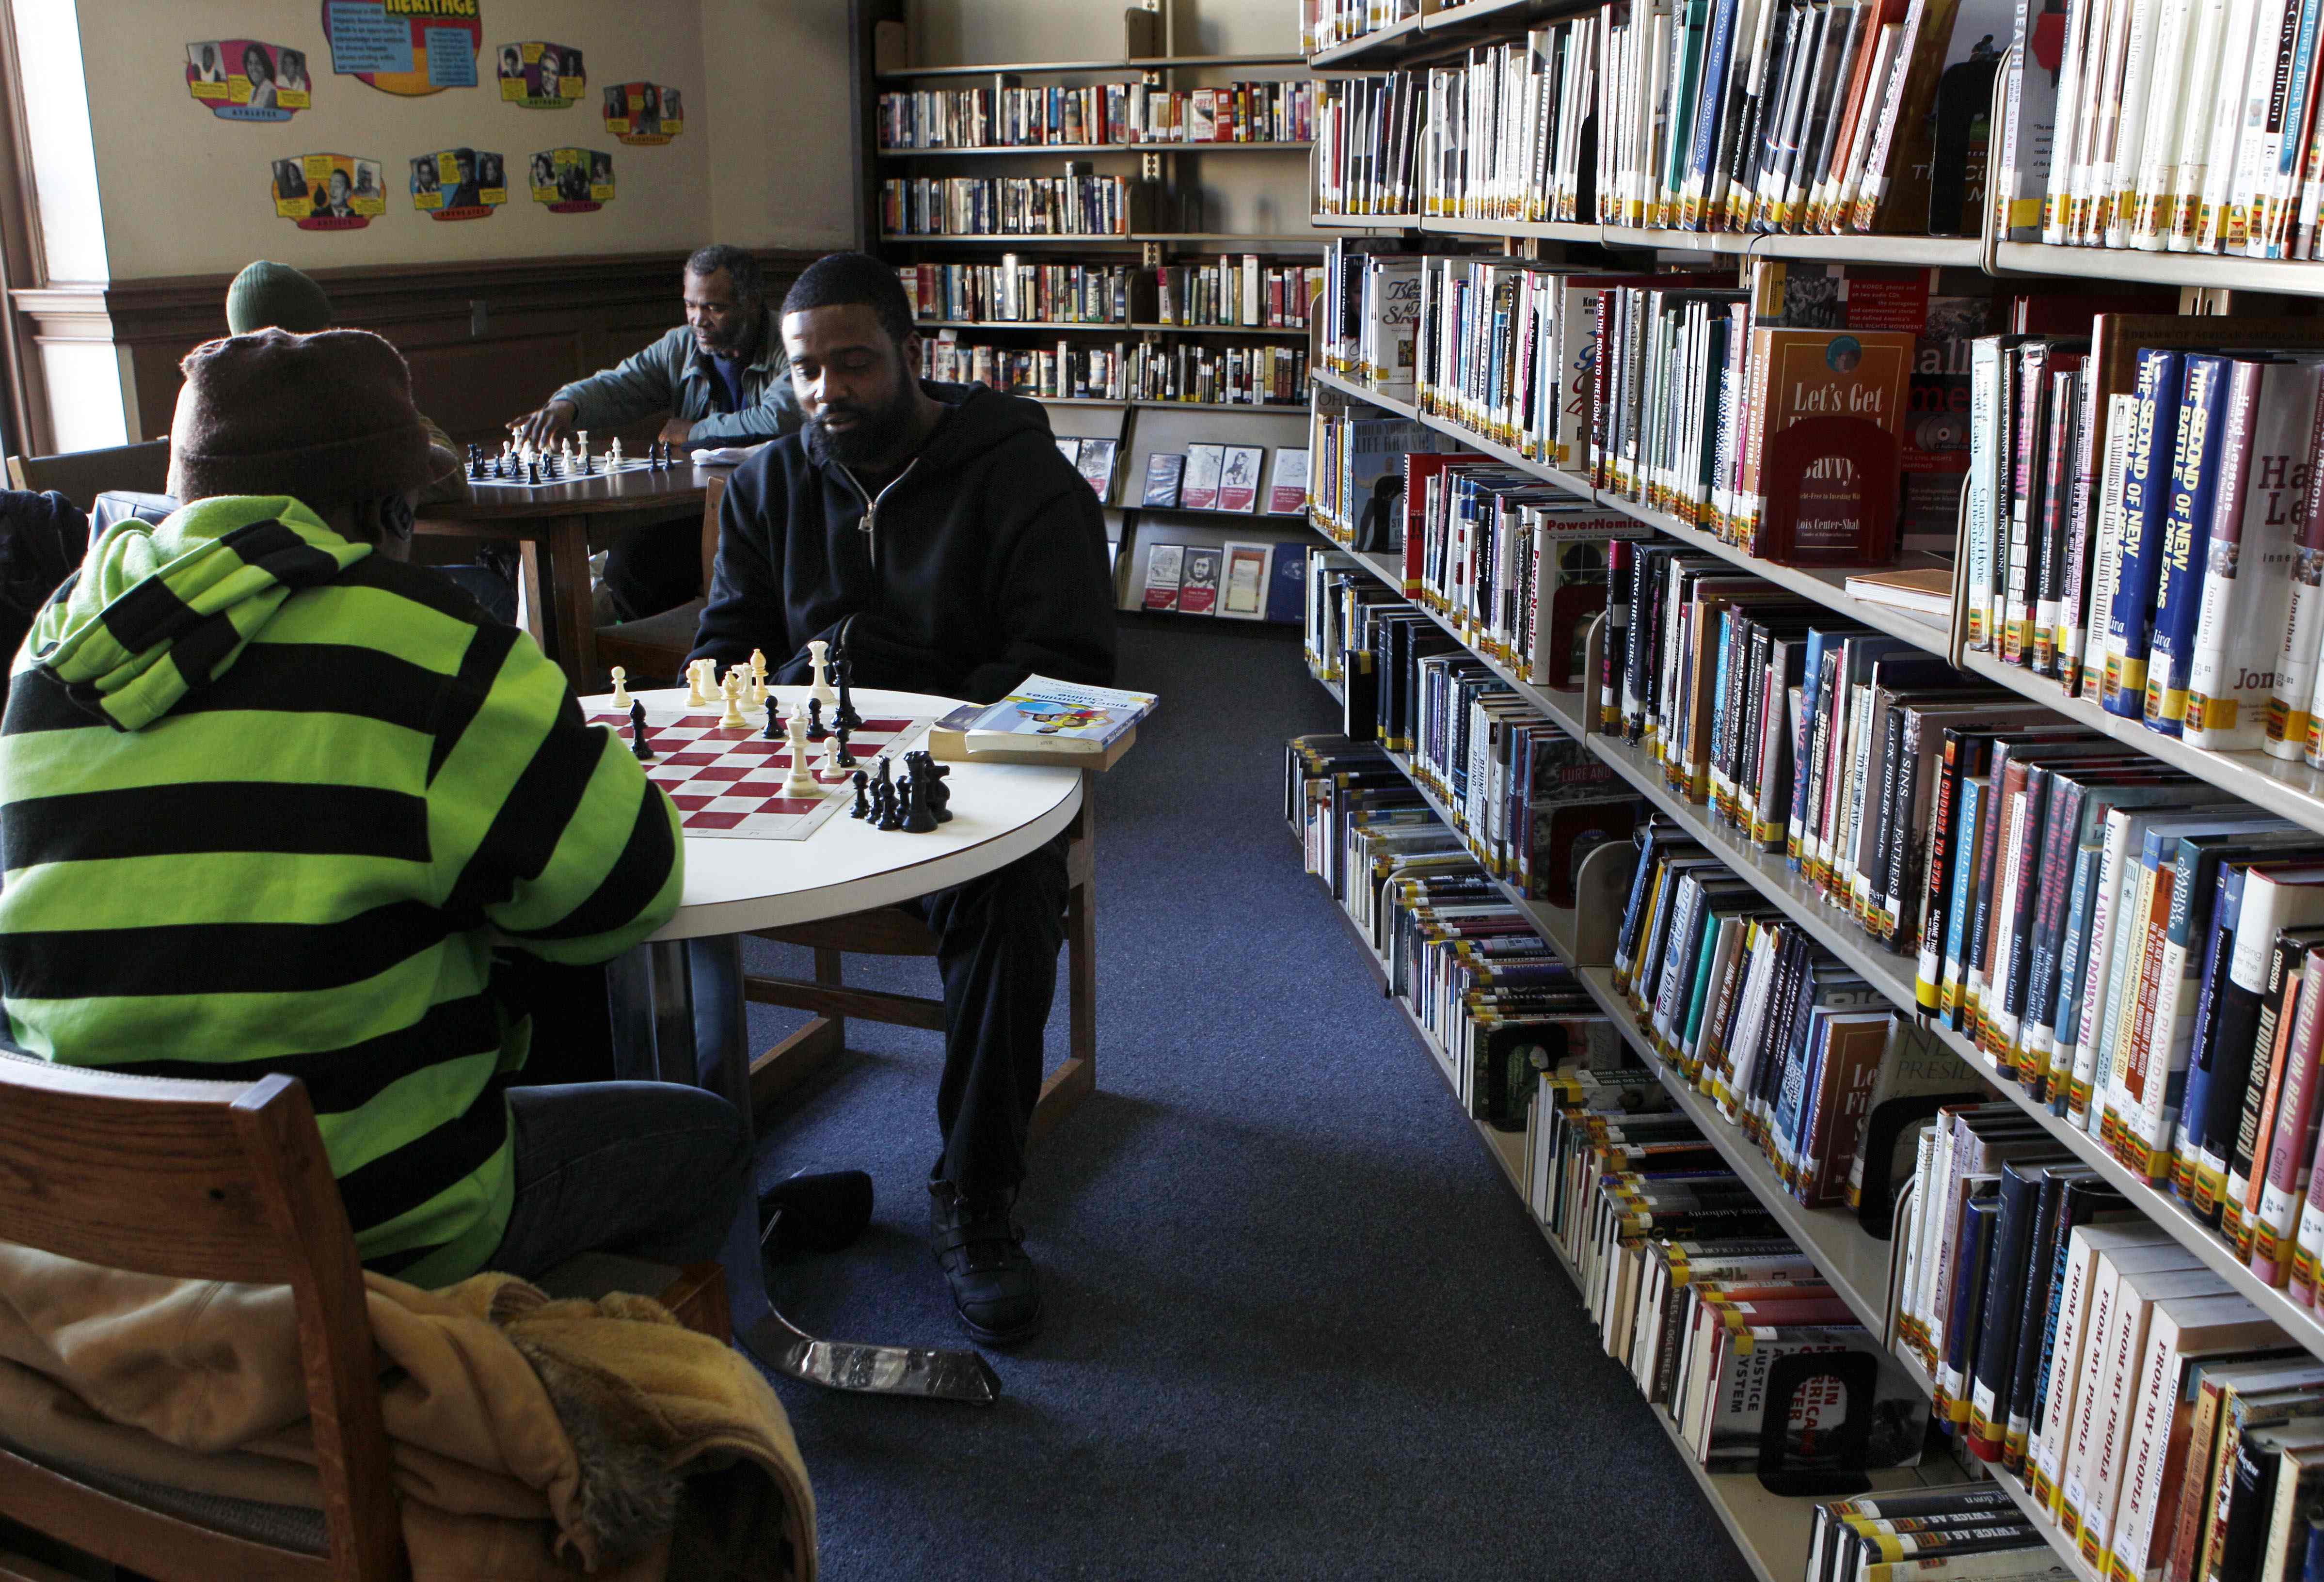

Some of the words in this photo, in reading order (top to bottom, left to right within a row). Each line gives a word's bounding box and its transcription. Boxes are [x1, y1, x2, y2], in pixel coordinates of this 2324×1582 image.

[2011, 4, 2027, 66] DEATH
[2006, 111, 2015, 148] SUSAN
[1598, 302, 1605, 315] ON
[1595, 363, 1602, 375] TO
[1752, 354, 1761, 408] FREEDOM'S
[2138, 362, 2153, 395] THE
[2189, 368, 2208, 401] THE
[1592, 377, 1601, 422] FREEDOM
[1794, 382, 1842, 411] Let's
[1849, 382, 1884, 412] Get
[2126, 398, 2141, 471] BATTLE
[2233, 395, 2250, 438] Hard
[1746, 410, 1758, 466] DAUGHTERS
[2133, 398, 2156, 480] SECOND
[2172, 405, 2190, 481] BATTLE
[2182, 408, 2208, 491] SECOND
[2127, 483, 2143, 507] OF
[2224, 443, 2243, 512] Lessons
[2309, 449, 2324, 520] Lessons
[1546, 517, 1646, 531] PowerNomics
[2176, 493, 2192, 519] OF
[2125, 510, 2143, 558] NEW
[2172, 522, 2192, 571] NEW
[2157, 518, 2175, 609] ORLEANS
[1528, 550, 1540, 650] PowerNomics
[2201, 585, 2217, 644] Jonathan
[2153, 628, 2172, 648] Liva
[2285, 591, 2301, 652] Jonathan
[1628, 621, 1637, 665] WATERS
[1885, 718, 1896, 760] BLACK
[1562, 767, 1587, 781] LURE
[1881, 762, 1894, 815] FIDDLER
[1899, 758, 1911, 797] SINS
[1937, 778, 1952, 835] CHOOSE
[1967, 789, 1978, 823] AND
[1935, 838, 1946, 855] TO
[1962, 826, 1974, 867] STILL
[2104, 823, 2116, 849] Joe
[1889, 828, 1904, 896] FATHERS
[1930, 857, 1943, 893] STAY
[2099, 851, 2113, 886] Clark
[1960, 873, 1971, 892] WE
[2144, 871, 2152, 896] BLACK
[2169, 857, 2185, 930] COHODAS
[2176, 868, 2191, 925] NADINE
[1957, 897, 1969, 931] RISE
[2089, 891, 2109, 956] LAYING
[2140, 899, 2149, 923] EXCEL
[2149, 922, 2159, 933] THE
[2134, 926, 2145, 964] AFRICAN
[2147, 933, 2156, 952] BLACK
[2154, 940, 2165, 960] BLACK
[2157, 928, 2166, 940] THE
[1724, 961, 1735, 988] LIVING
[2083, 956, 2100, 1008] DOWN
[2143, 953, 2154, 980] STUDENT
[2151, 960, 2163, 985] STUDENT
[2269, 948, 2283, 993] CORSON
[1721, 985, 1730, 998] IN
[2127, 965, 2139, 1012] AMERICAN
[2138, 980, 2149, 1004] PROTEST
[2147, 986, 2158, 1010] PROTEST
[2164, 967, 2176, 1013] BAND
[1716, 996, 1728, 1023] LIVING
[2134, 1004, 2145, 1034] MOVEMENT
[2143, 1011, 2154, 1042] MOVEMENT
[2298, 970, 2322, 1053] WHEELIN'
[1713, 1020, 1722, 1038] OUT
[2078, 1010, 2092, 1048] THE
[2120, 1012, 2133, 1057] STUDENT'S
[2133, 1035, 2140, 1044] AT
[2141, 1043, 2149, 1051] AT
[2129, 1044, 2138, 1070] RUTGERS
[2136, 1052, 2148, 1077] RUTGERS
[2152, 1017, 2169, 1081] PLAYED
[2292, 1057, 2306, 1080] ON
[2147, 1082, 2161, 1116] DIXI
[2246, 1086, 2260, 1113] or
[2280, 1085, 2301, 1138] BEALE
[2236, 1107, 2257, 1161] peril
[2068, 1261, 2082, 1319] FROM
[2095, 1286, 2110, 1345] FROM
[2064, 1322, 2074, 1352] MY
[2119, 1310, 2133, 1366] FROM
[1730, 1353, 1750, 1413] YSTEM
[1748, 1348, 1768, 1412] JUSTICE
[2090, 1349, 2101, 1380] MY
[2151, 1339, 2167, 1401] FROM
[2051, 1356, 2068, 1429] PEOPLE
[2112, 1371, 2123, 1406] MY
[2077, 1384, 2095, 1456] PEOPLE
[2147, 1405, 2157, 1437] MY
[2100, 1409, 2118, 1484] PEOPLE
[2130, 1441, 2151, 1515] PEOPLE
[1949, 1511, 1996, 1522] TWICE
[1952, 1530, 1970, 1540] AS
[1972, 1527, 2020, 1538] TWICE
